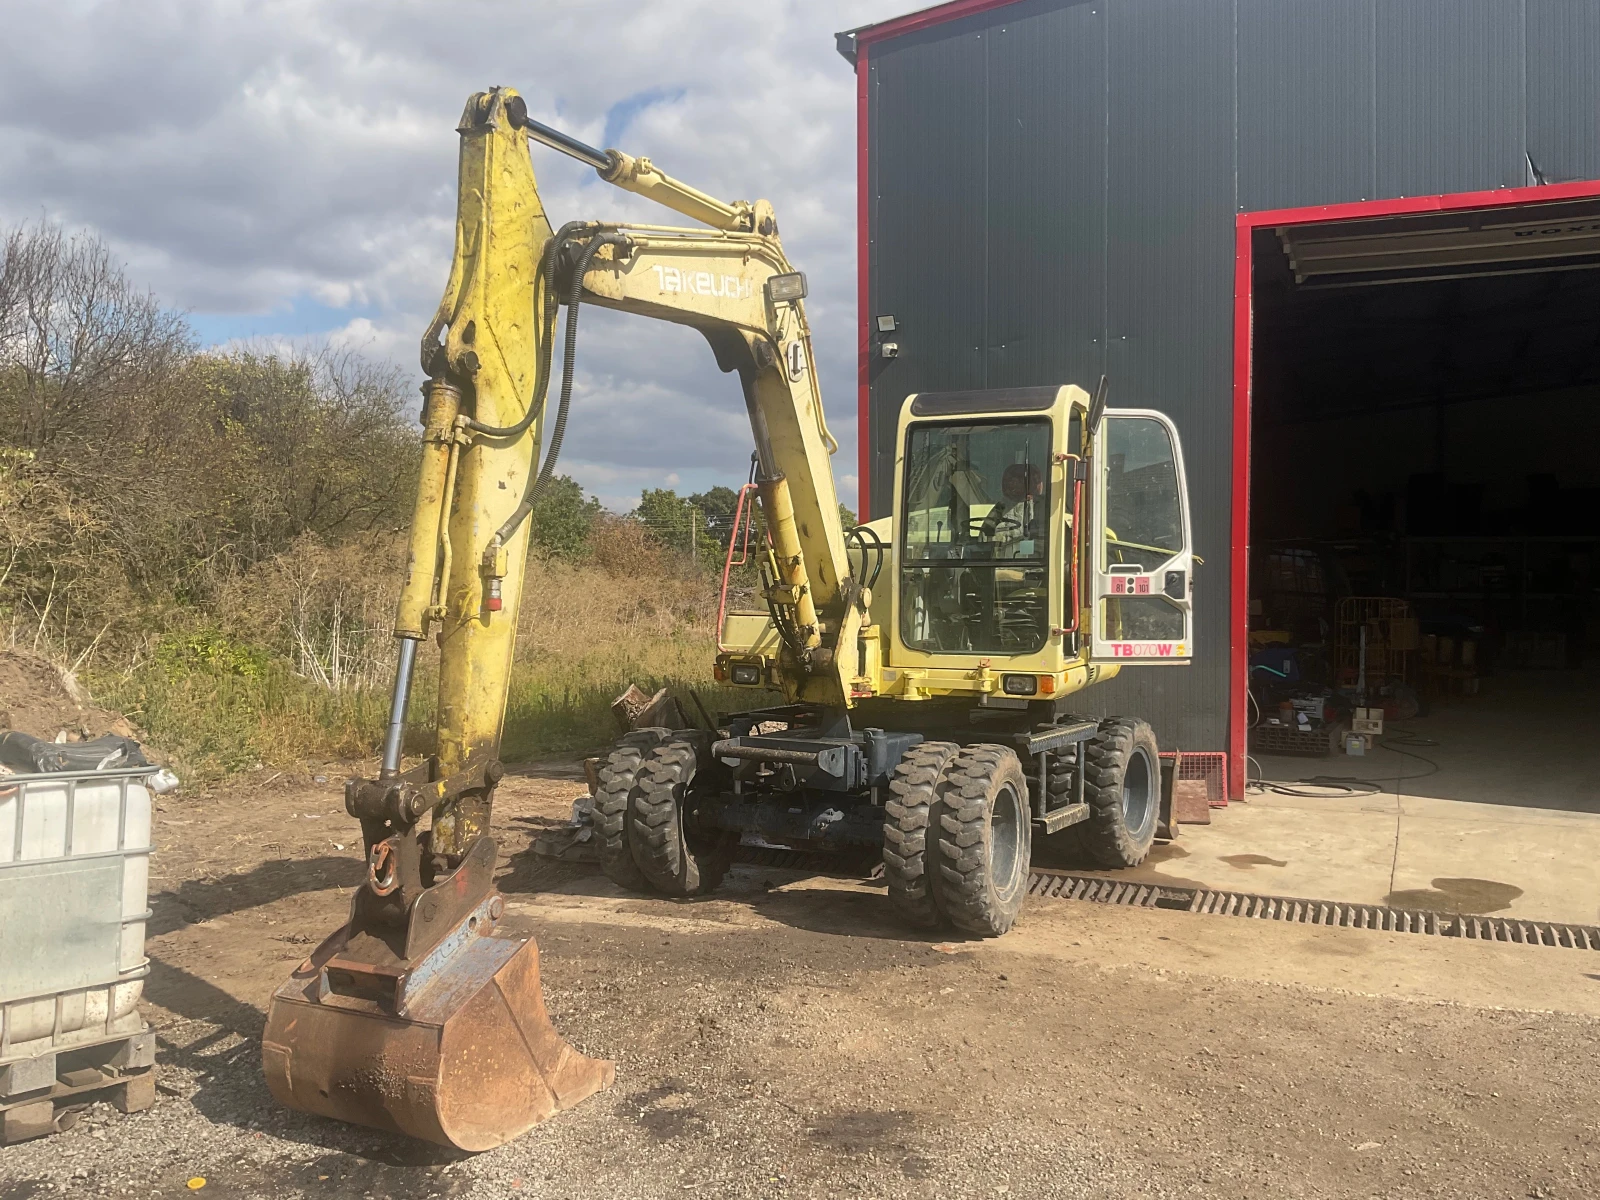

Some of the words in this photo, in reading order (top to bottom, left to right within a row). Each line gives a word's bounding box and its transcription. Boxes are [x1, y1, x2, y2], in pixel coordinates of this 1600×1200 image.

[1116, 584, 1123, 593] 81
[1139, 584, 1149, 593] 101
[1111, 643, 1172, 656] TB070W
